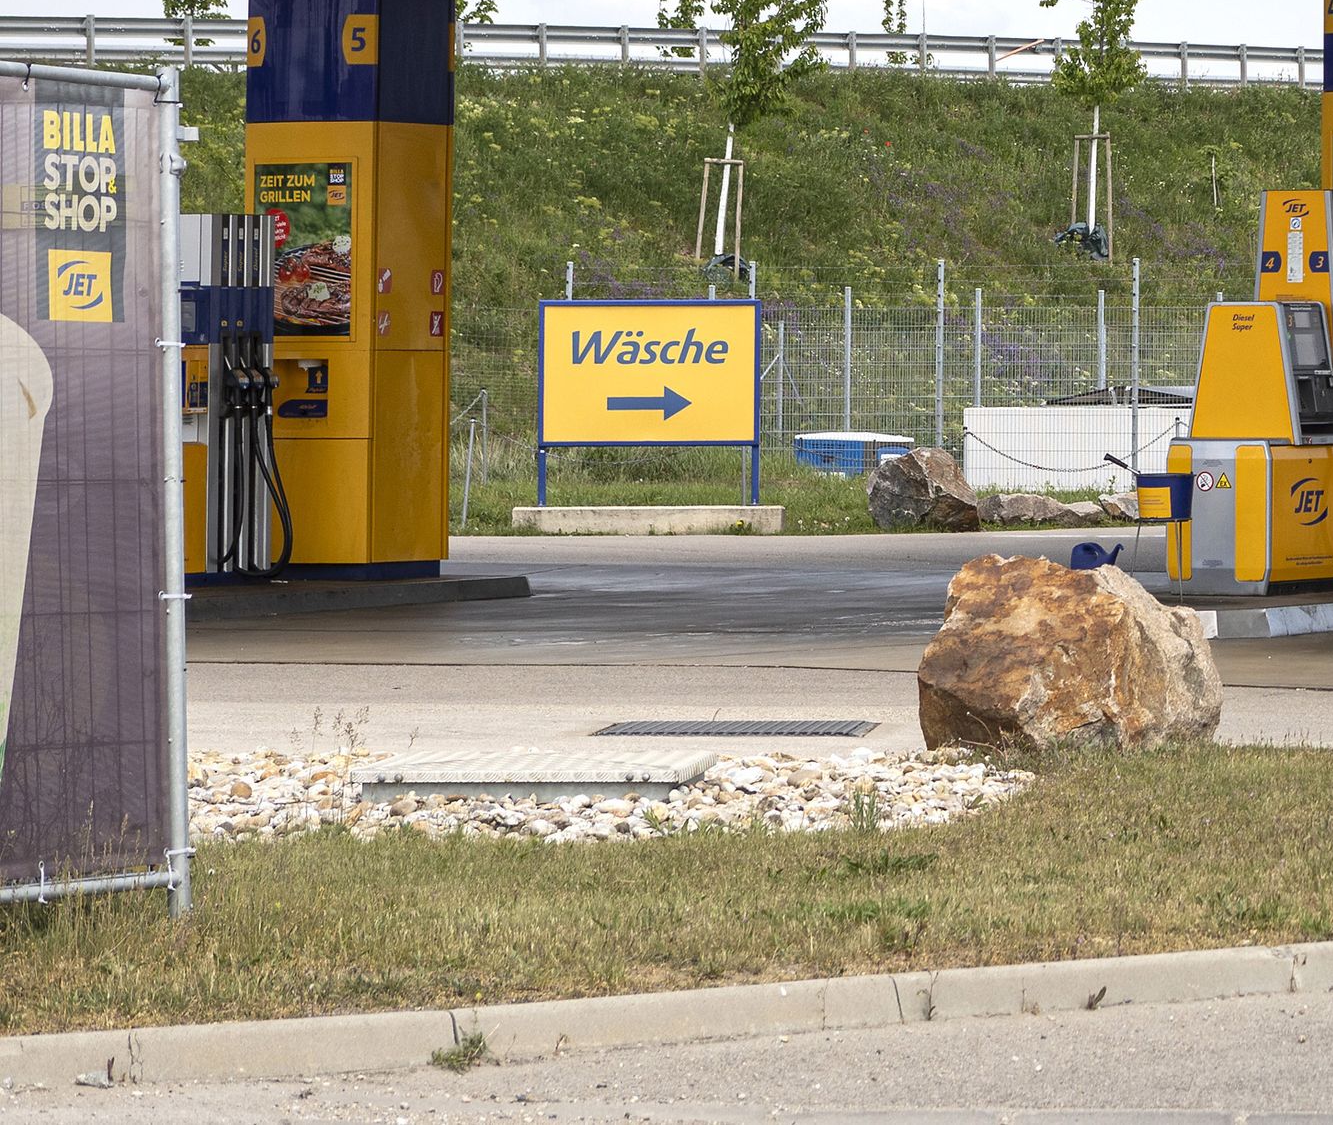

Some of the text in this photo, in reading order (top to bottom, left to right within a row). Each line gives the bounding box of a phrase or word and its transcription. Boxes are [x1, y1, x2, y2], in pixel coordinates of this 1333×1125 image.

[250, 28, 261, 55] 6
[350, 27, 366, 52] 5
[43, 110, 116, 154] BILLA
[44, 153, 117, 195] STOP &
[259, 174, 316, 188] ZEIT ZUM
[259, 189, 312, 203] GRILLEN
[44, 192, 118, 233] SHOP
[1285, 203, 1307, 213] JET
[1265, 257, 1275, 268] 4
[1315, 256, 1324, 268] 3
[62, 273, 97, 297] JET
[1231, 322, 1253, 332] Super
[1232, 313, 1255, 322] Diesel
[571, 327, 729, 365] Wäsche
[1219, 480, 1228, 488] EX
[1294, 489, 1324, 514] JET
